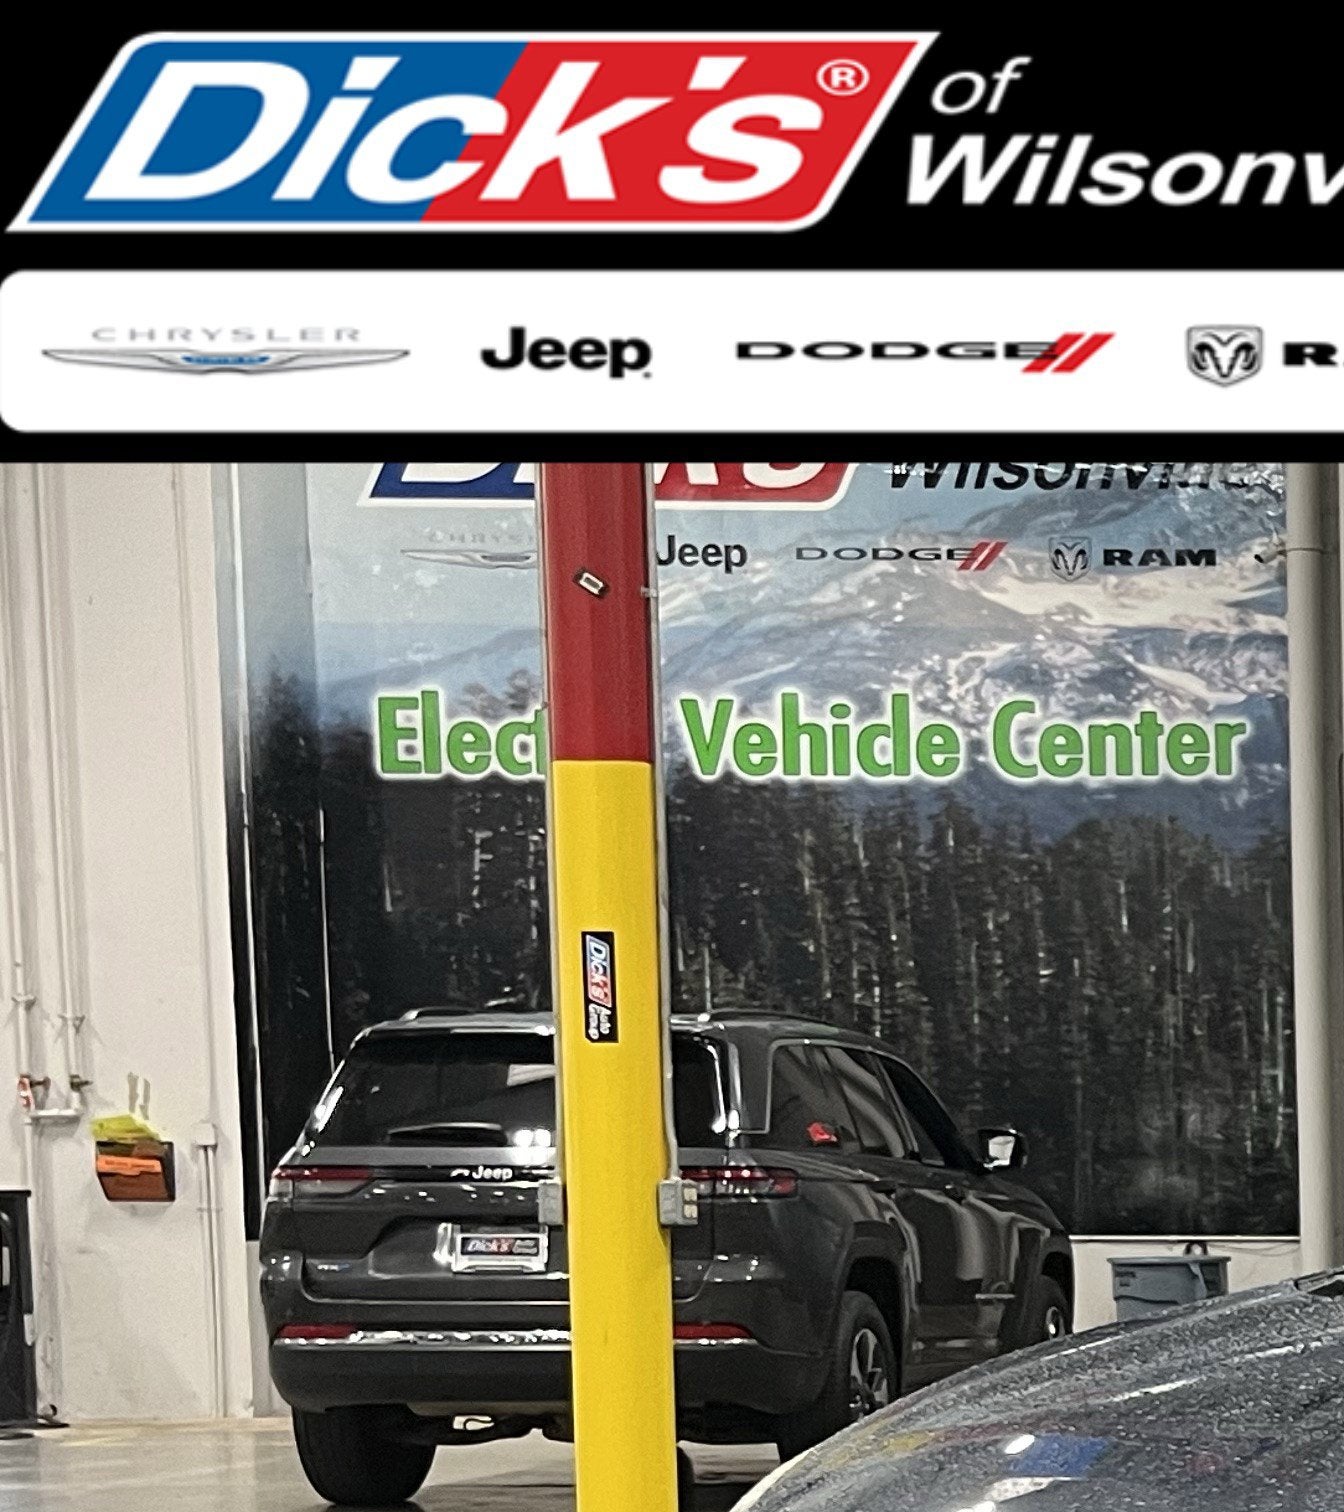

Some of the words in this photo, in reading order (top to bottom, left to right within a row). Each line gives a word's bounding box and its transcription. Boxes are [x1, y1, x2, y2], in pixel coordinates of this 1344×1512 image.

[653, 535, 747, 574] Jeep
[795, 546, 975, 563] DODGE
[1102, 548, 1218, 567] RAM
[680, 692, 960, 777] Vehicle
[992, 699, 1246, 777] Center
[471, 1165, 513, 1181] Jeep
